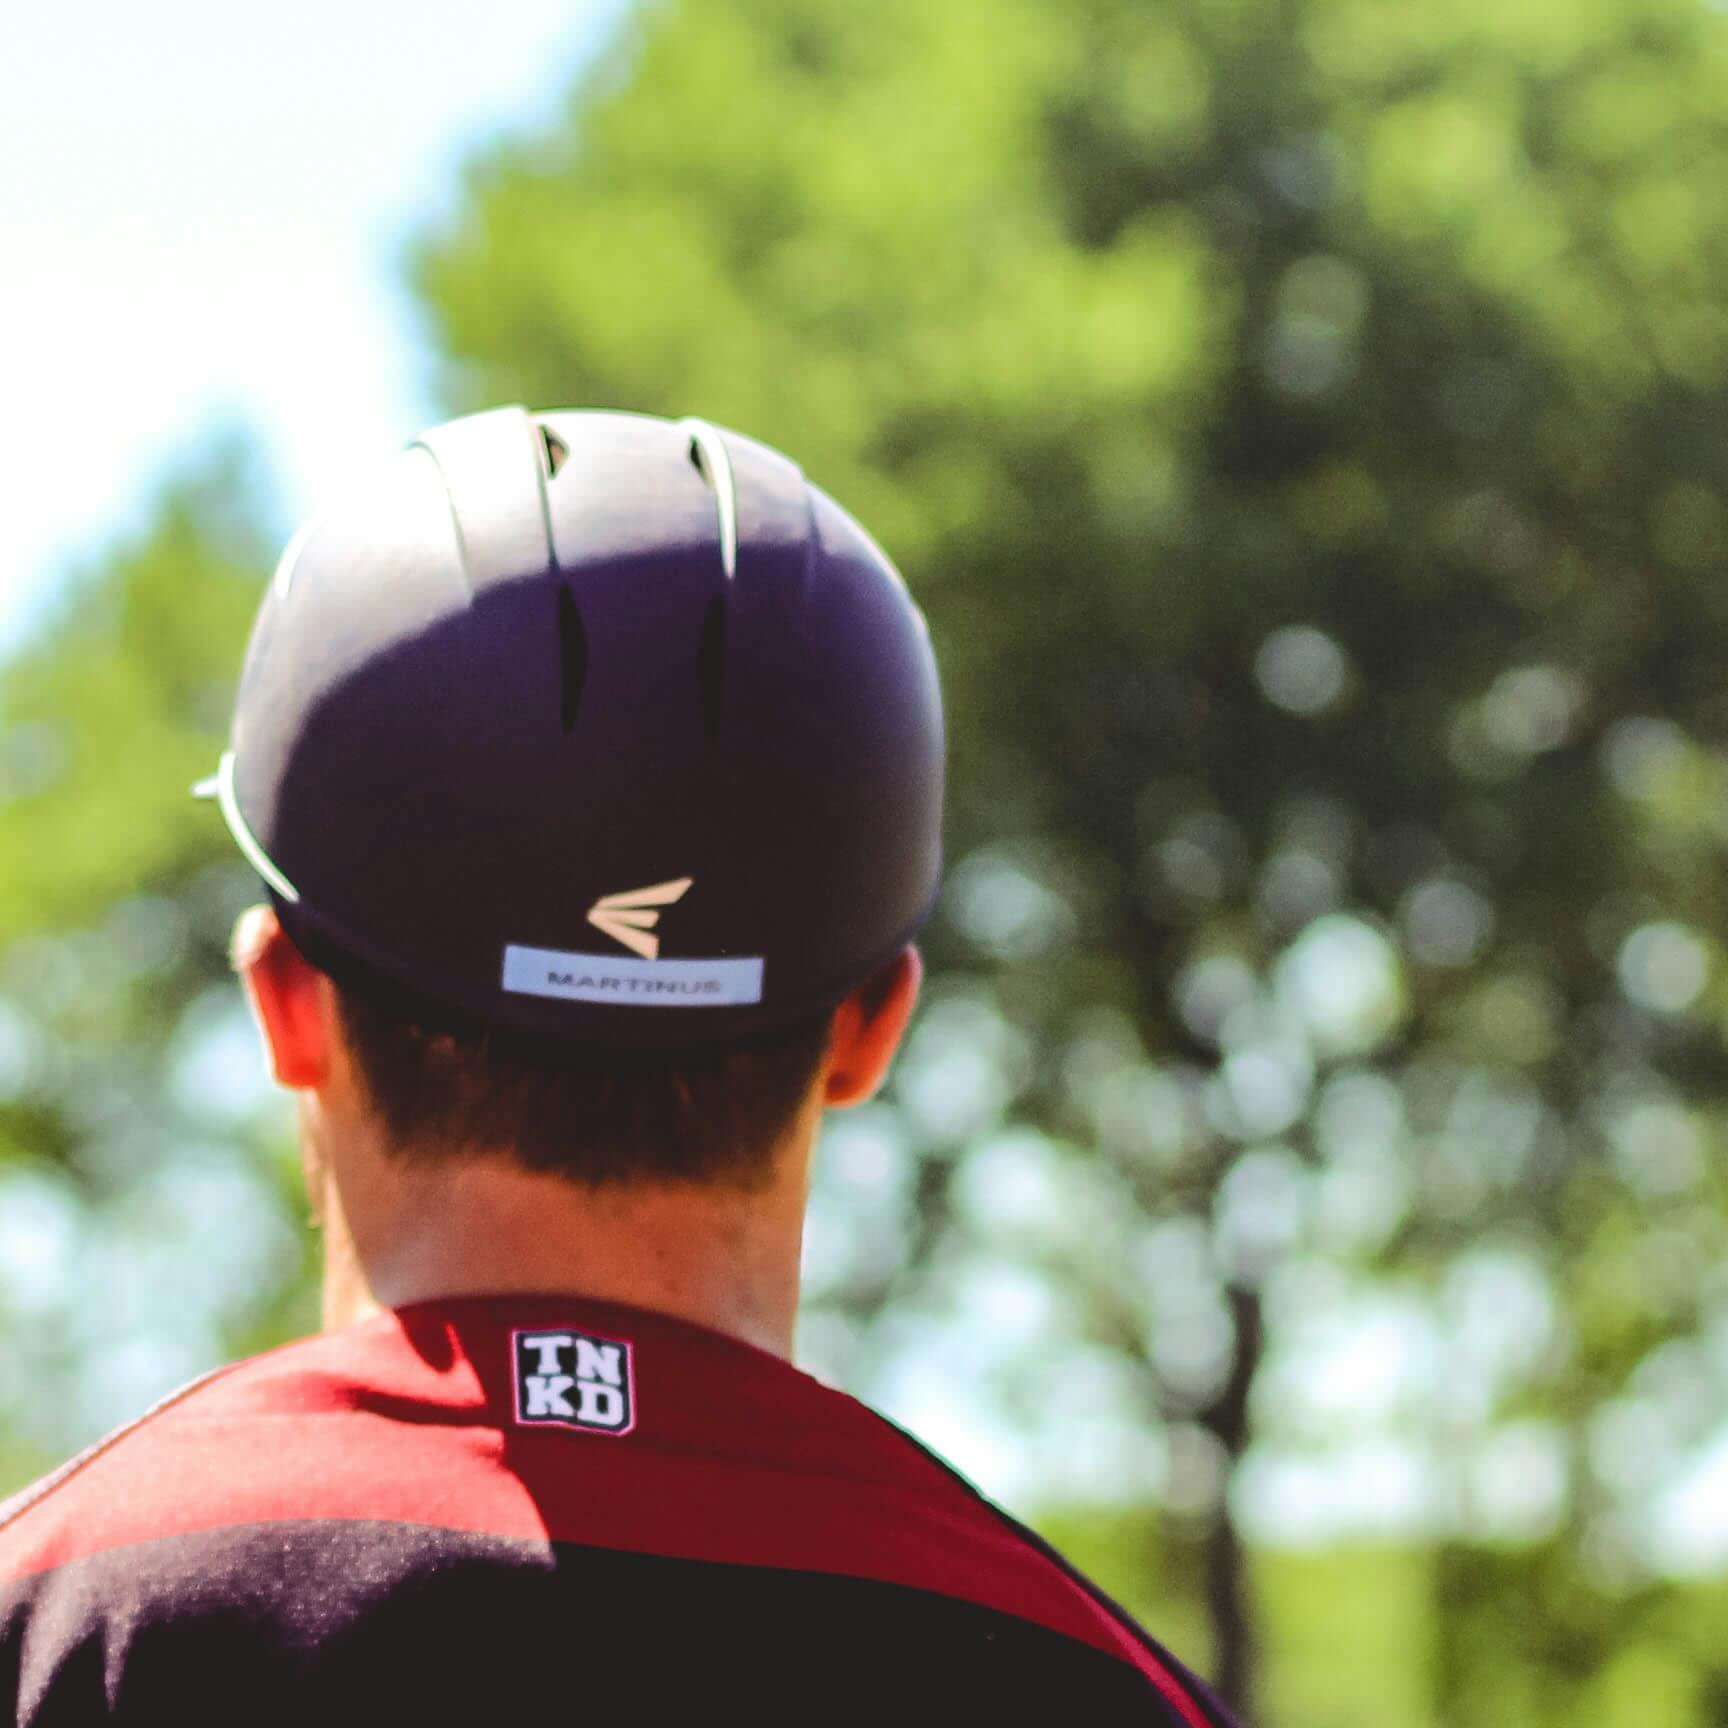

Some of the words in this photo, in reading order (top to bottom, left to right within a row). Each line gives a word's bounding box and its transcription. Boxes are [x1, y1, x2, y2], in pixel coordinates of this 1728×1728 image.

[546, 970, 723, 994] MARTINUS
[523, 1335, 622, 1385] TN
[525, 1375, 624, 1426] KD
